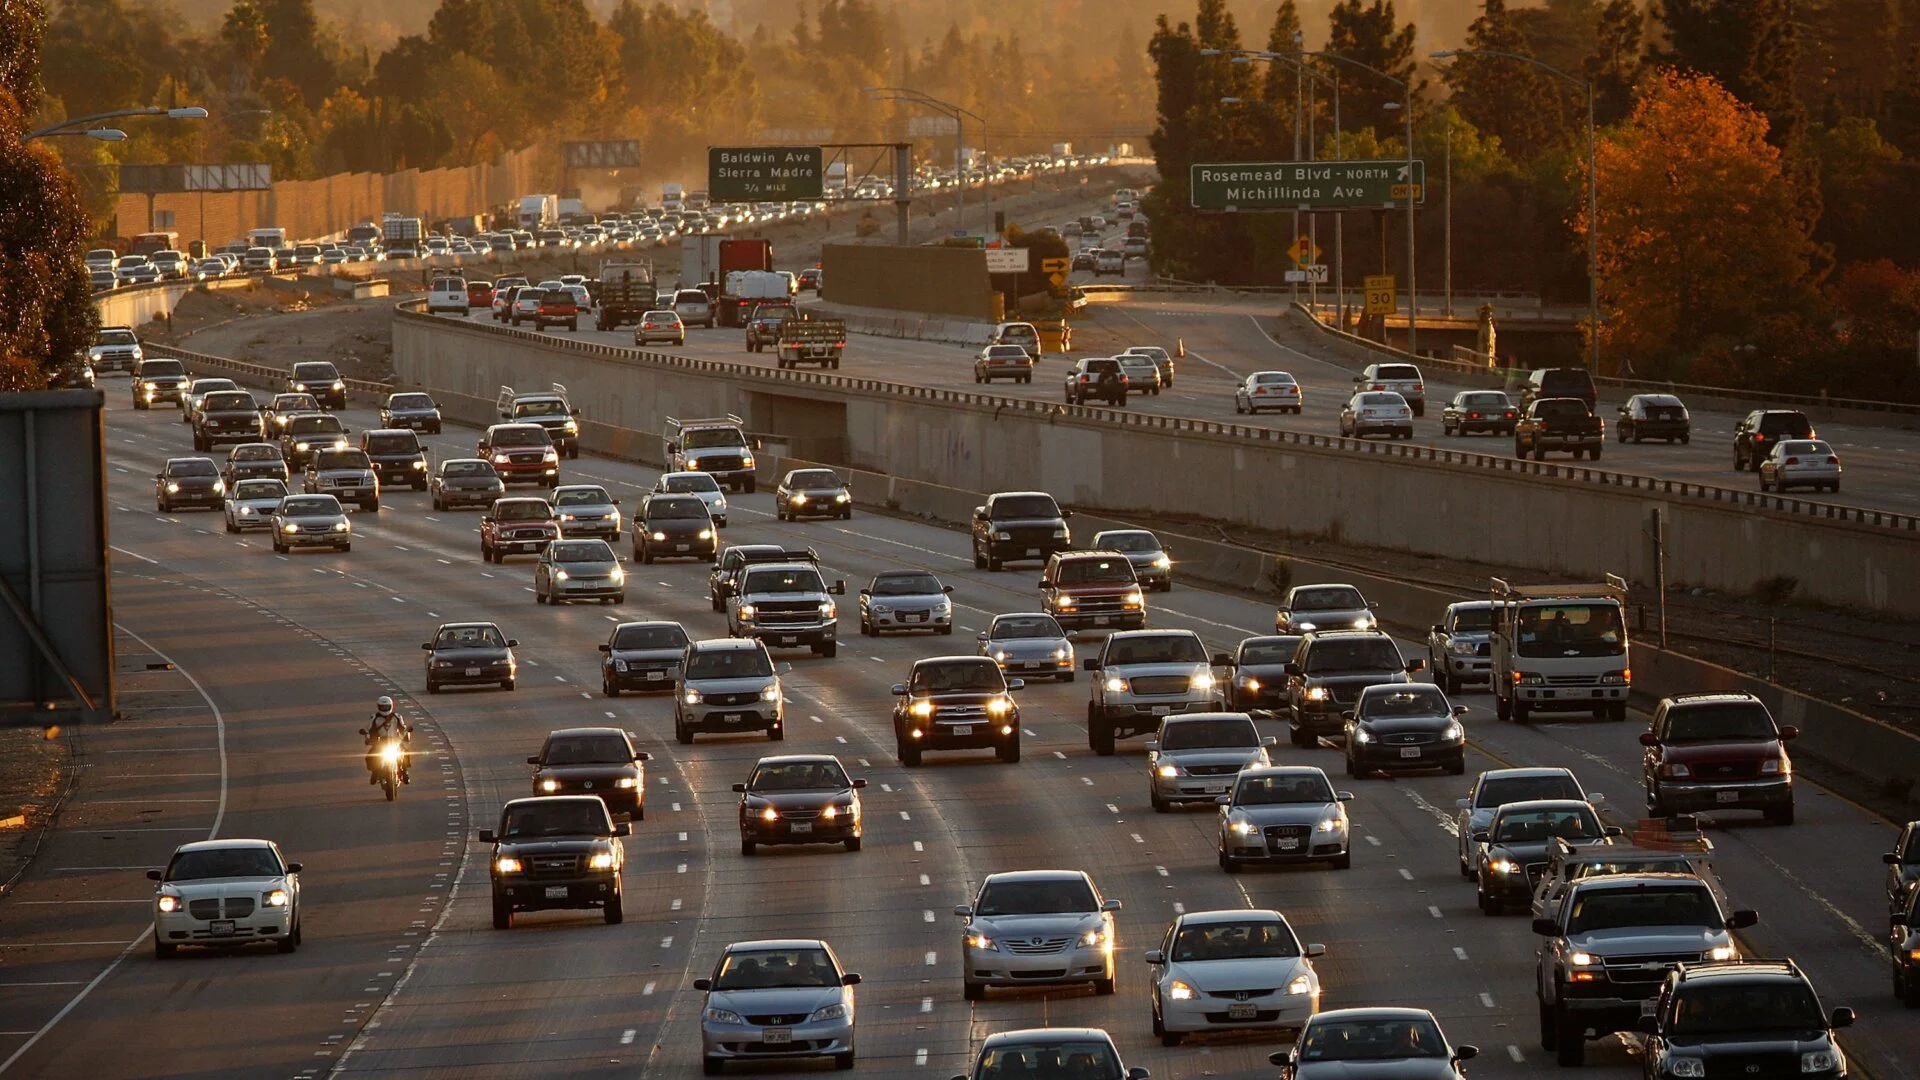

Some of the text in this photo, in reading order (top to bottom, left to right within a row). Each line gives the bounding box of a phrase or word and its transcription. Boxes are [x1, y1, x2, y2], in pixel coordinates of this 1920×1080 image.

[721, 152, 811, 163] Baldwin Ave
[718, 167, 813, 178] Sierra Madre
[1201, 169, 1283, 182] Rosemead
[1295, 168, 1331, 180] Blvd
[1346, 169, 1389, 180] NORTH
[765, 183, 787, 192] MILE
[1226, 186, 1364, 200] Michillinda Ave
[1392, 187, 1419, 197] ONY
[1370, 292, 1391, 305] 30
